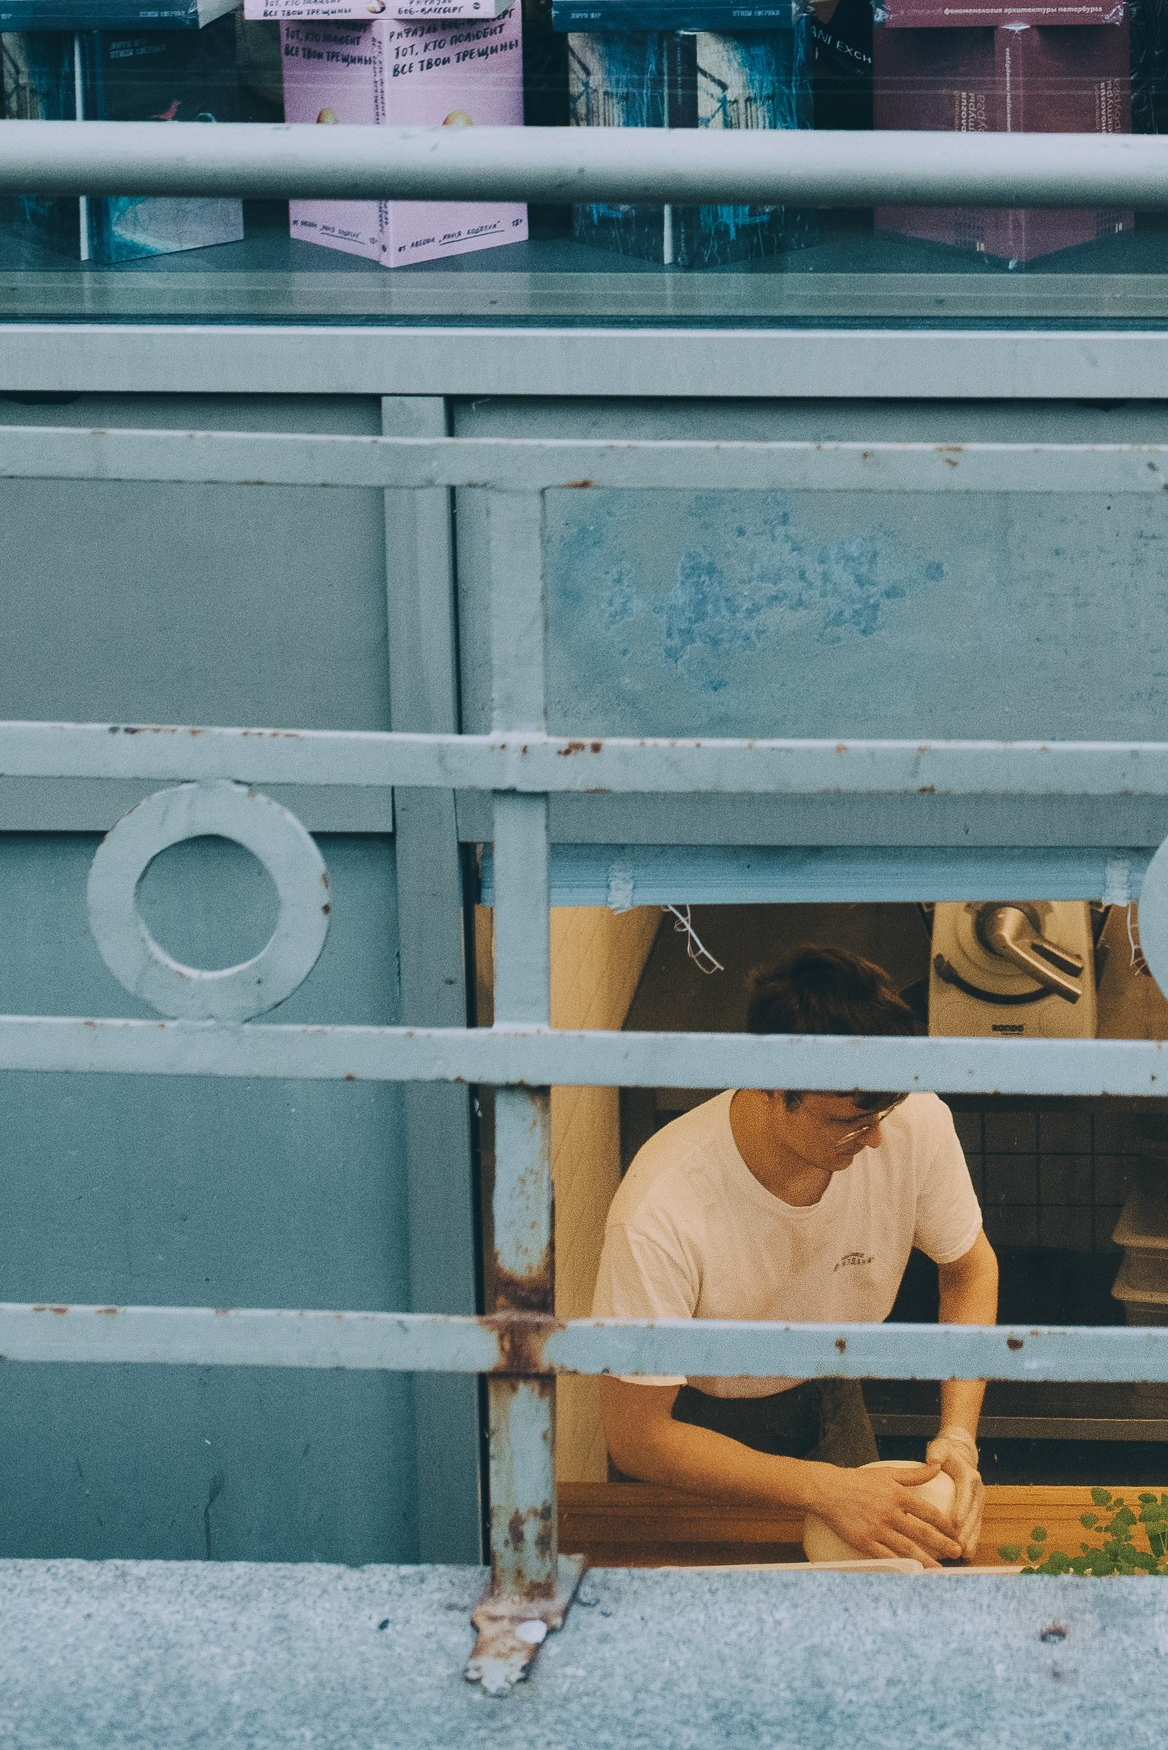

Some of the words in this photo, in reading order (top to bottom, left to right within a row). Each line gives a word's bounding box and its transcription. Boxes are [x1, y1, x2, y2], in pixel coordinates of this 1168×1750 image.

[944, 6, 1002, 16] феноменология
[1004, 6, 1057, 15] архитектуры
[1058, 5, 1103, 15] петербурга
[393, 63, 414, 77] ВСЕ
[419, 57, 450, 72] ТВОИ
[455, 39, 519, 63] ТРЕЩИНЫ
[394, 43, 419, 59] ТОТ,
[424, 39, 446, 52] КТО
[450, 24, 506, 45] ПОЛЮБИТ
